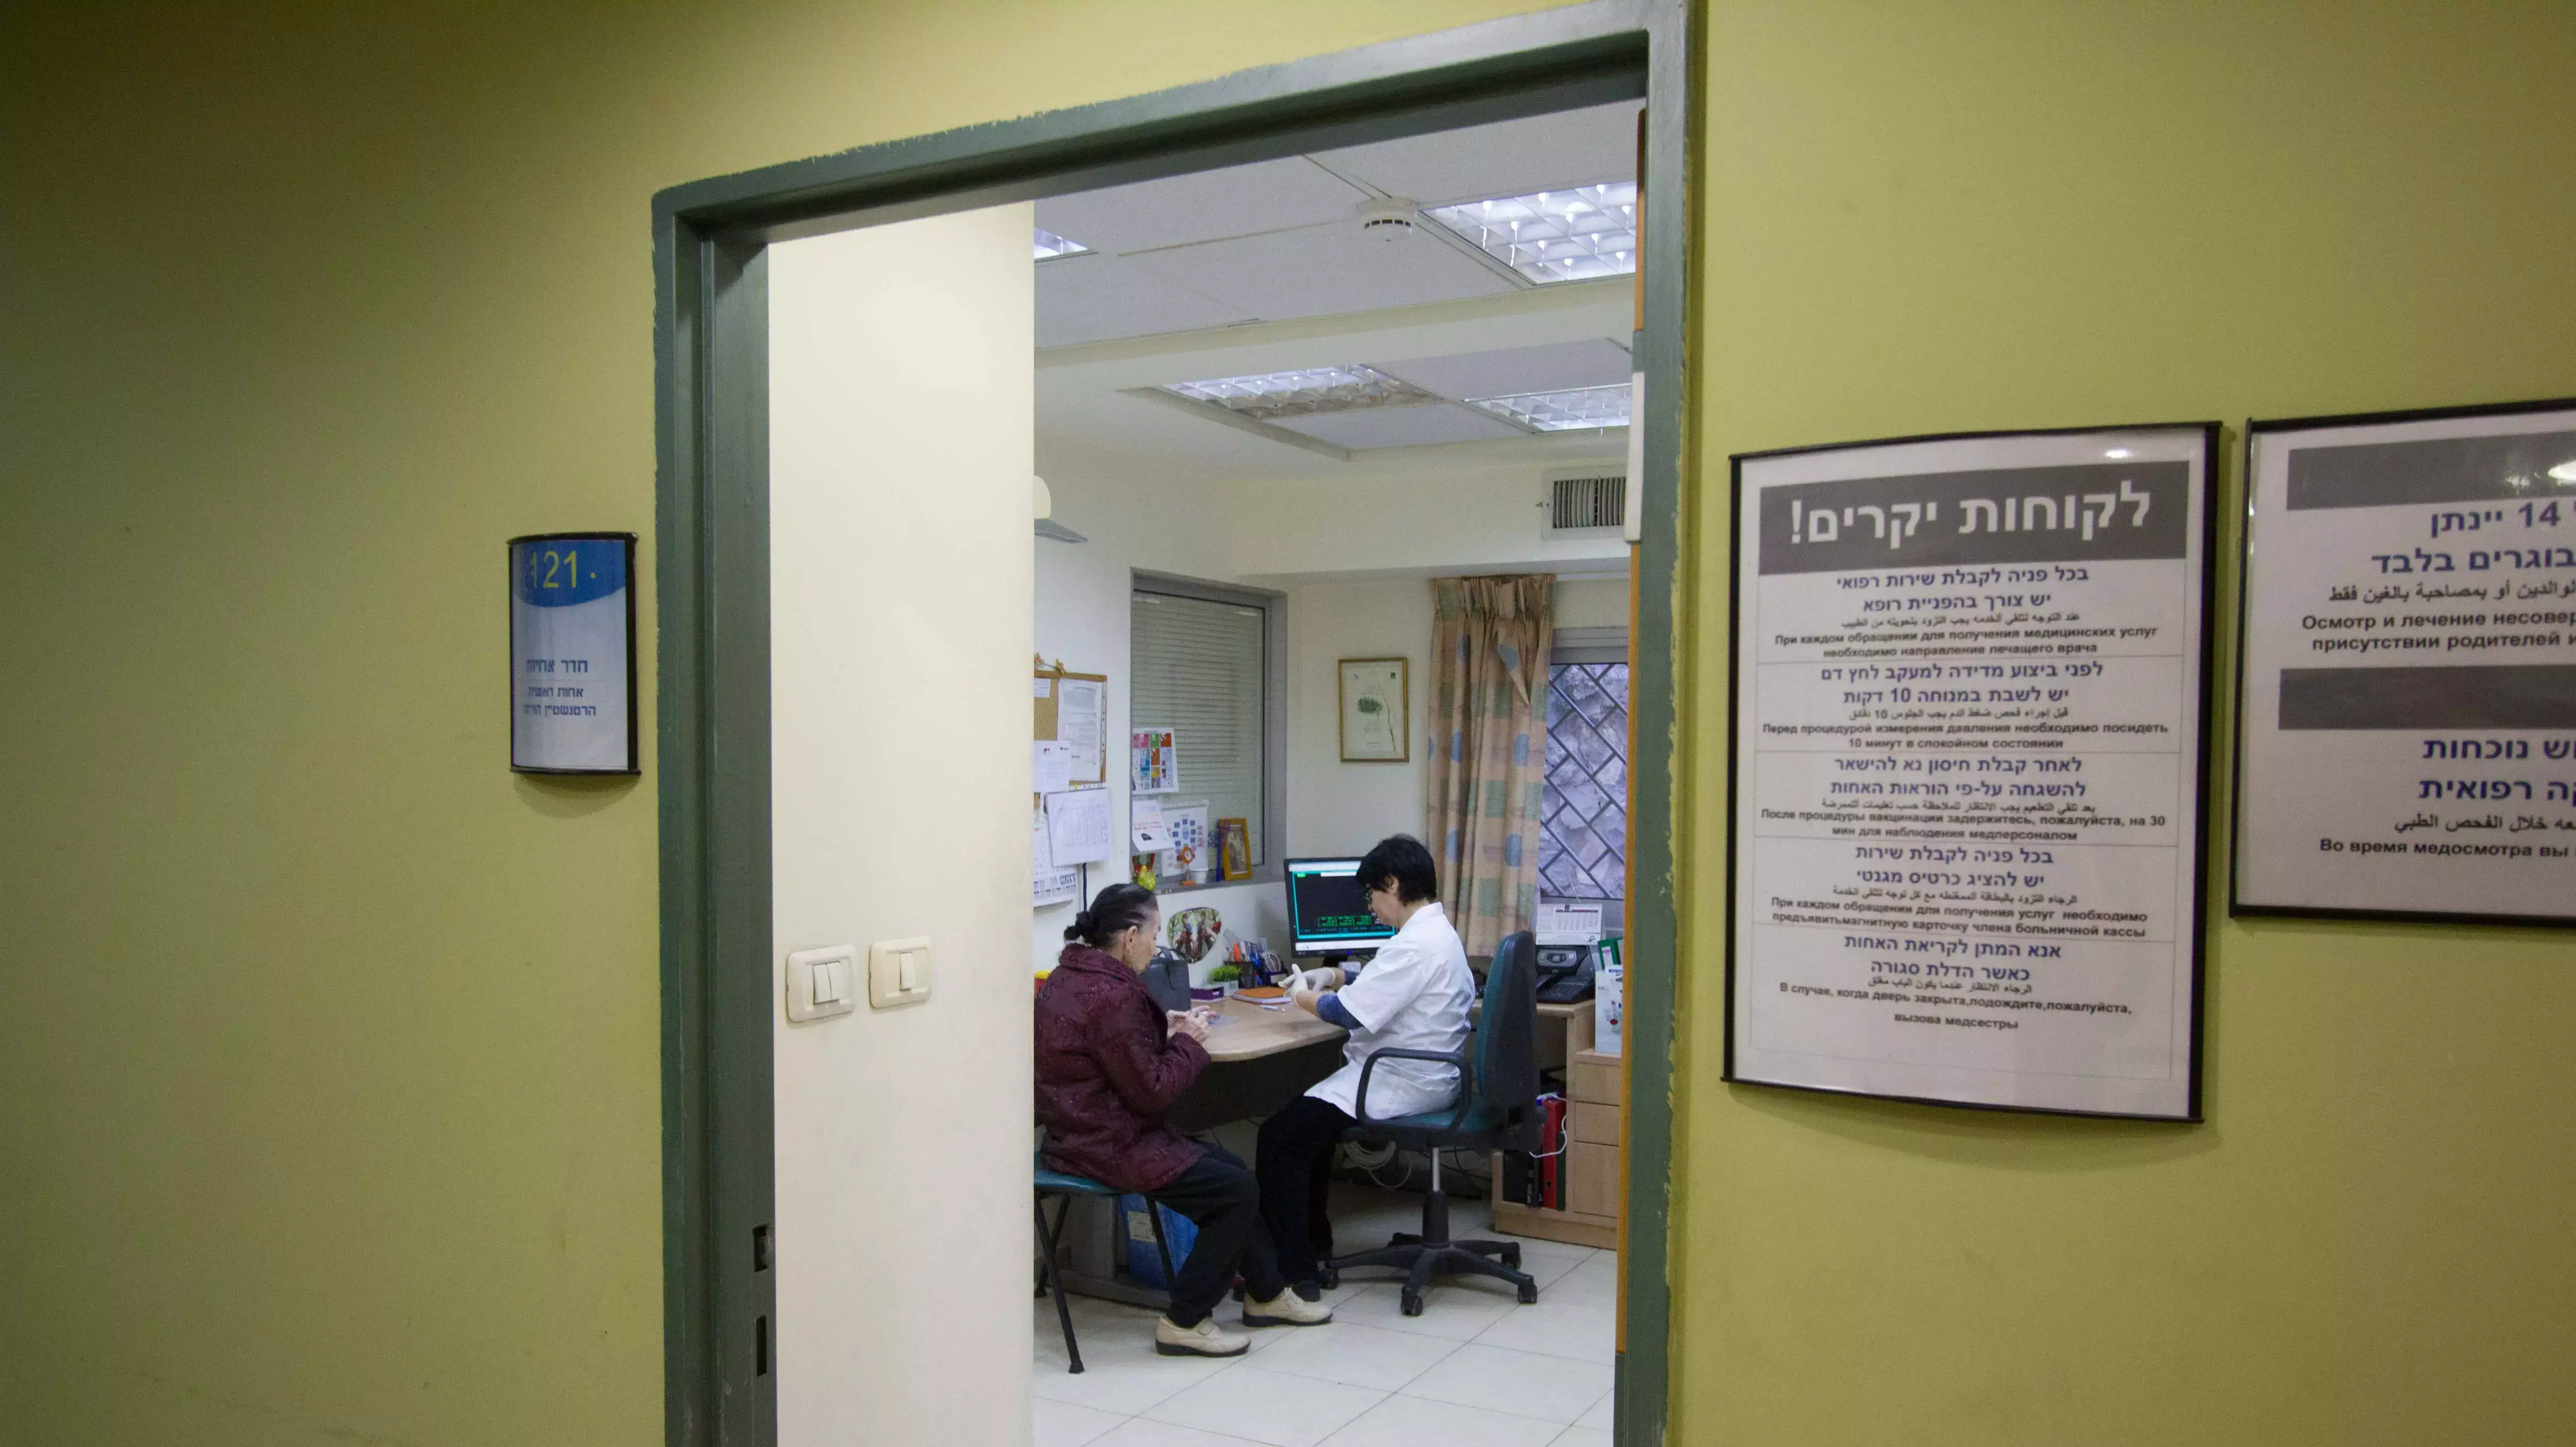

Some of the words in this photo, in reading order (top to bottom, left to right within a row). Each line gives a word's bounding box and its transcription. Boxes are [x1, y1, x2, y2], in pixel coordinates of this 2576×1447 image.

[1959, 480, 2150, 541] לקוחות
[2519, 501, 2560, 527] 14
[1791, 500, 1937, 550] יקרים!
[2431, 511, 2502, 538] יינתן
[2372, 548, 2455, 573] בלבד
[2469, 548, 2576, 570] בוגרים
[1886, 574, 1935, 587] שירות
[1942, 568, 2001, 587] לקבלת
[2009, 569, 2048, 582] פניה
[2055, 565, 2089, 581] בכל
[1837, 577, 1879, 588] רפואי
[1864, 599, 1901, 611] רופא
[1908, 597, 1977, 610] בהפניית
[1985, 595, 2023, 611] צורך
[2030, 595, 2051, 606] יש
[2302, 616, 2376, 631] Осмотр
[2384, 617, 2394, 627] и
[2401, 615, 2486, 627] лечение
[2494, 612, 2576, 626] несовер
[1775, 635, 1797, 646] При
[1801, 636, 1844, 644] каждом
[1848, 633, 1918, 643] обращении
[1921, 632, 1945, 641] для
[1949, 630, 2020, 641] получения
[2024, 629, 2115, 638] медицинских
[2120, 628, 2157, 639] услуг
[2313, 638, 2440, 653] присутствии
[2447, 632, 2560, 651] родителей
[1824, 647, 1897, 657] необходимо
[1901, 646, 1985, 657] направление
[1990, 645, 2053, 654] лечащего
[2058, 644, 2097, 655] врача
[561, 660, 588, 672] חדר
[1849, 664, 1879, 683] לחץ
[1886, 663, 1942, 682] למעקב
[1949, 666, 2004, 677] מדידה
[2011, 665, 2058, 678] ביצוע
[2065, 661, 2102, 676] לפני
[1822, 669, 1842, 680] דם
[1844, 692, 1883, 707] דקות
[1891, 688, 1911, 703] 10
[1918, 691, 1981, 702] במנוחה
[1989, 686, 2041, 702] לשבת
[2048, 690, 2069, 701] יש
[1763, 724, 1797, 734] Перед
[1801, 724, 1872, 735] процедурой
[1876, 725, 1943, 734] измерения
[1947, 725, 2011, 733] давления
[2015, 723, 2098, 733] необходимо
[2103, 724, 2168, 734] посидеть
[1849, 738, 1862, 747] 10
[1865, 740, 1902, 750] минут
[1918, 739, 1988, 748] спокойном
[2423, 740, 2528, 759] נוכחות
[1836, 756, 1897, 770] להישאר
[1904, 760, 1922, 771] נא
[1929, 760, 1970, 774] חיסון
[1978, 756, 2026, 775] קבלת
[2034, 757, 2082, 772] לאחר
[1831, 782, 1883, 794] האחות
[1890, 783, 1948, 795] הוראות
[2010, 781, 2086, 796] להשגחה
[2419, 781, 2532, 800] רפואית
[1762, 809, 1795, 819] После
[1799, 812, 1865, 822] процедуры
[1869, 814, 1943, 823] вакцинации
[2040, 815, 2124, 827] пожалуйста,
[2151, 815, 2166, 826] 30
[1886, 827, 1965, 838] наблюдения
[1969, 831, 2078, 841] медперсоналом
[1856, 847, 1903, 860] שירות
[1910, 846, 1967, 864] לקבלת
[2020, 848, 2053, 863] בכל
[2320, 838, 2344, 851] Во
[2350, 843, 2407, 855] время
[2414, 844, 2532, 859] медосмотра
[2540, 847, 2568, 857] вы
[1975, 850, 2013, 863] פניה
[1857, 871, 1903, 883] מגנטי
[1909, 872, 1960, 885] כרטיס
[1967, 871, 2017, 886] להציג
[2024, 876, 2044, 887] יש
[1772, 897, 1793, 908] При
[1797, 901, 1840, 910] каждом
[1844, 901, 1913, 913] обращении
[1944, 908, 2014, 918] получения
[2018, 911, 2055, 921] услуг
[2063, 910, 2147, 922] необходимо
[1913, 922, 1968, 933] карточку
[1973, 924, 2012, 933] члена
[2015, 923, 2098, 935] больничной
[1846, 937, 1898, 950] האחות
[1905, 939, 1968, 957] לקריאת
[1975, 944, 2020, 958] המתן
[2028, 946, 2060, 958] אנא
[1871, 962, 1920, 975] סגורה
[1927, 962, 1974, 978] הדלת
[1982, 967, 2030, 981] כאשר
[1780, 982, 1788, 992] В
[1837, 990, 1869, 999] когда
[1872, 992, 1911, 1002] дверь
[1895, 1014, 1941, 1024] вызова
[1945, 1018, 2018, 1030] медсестры
